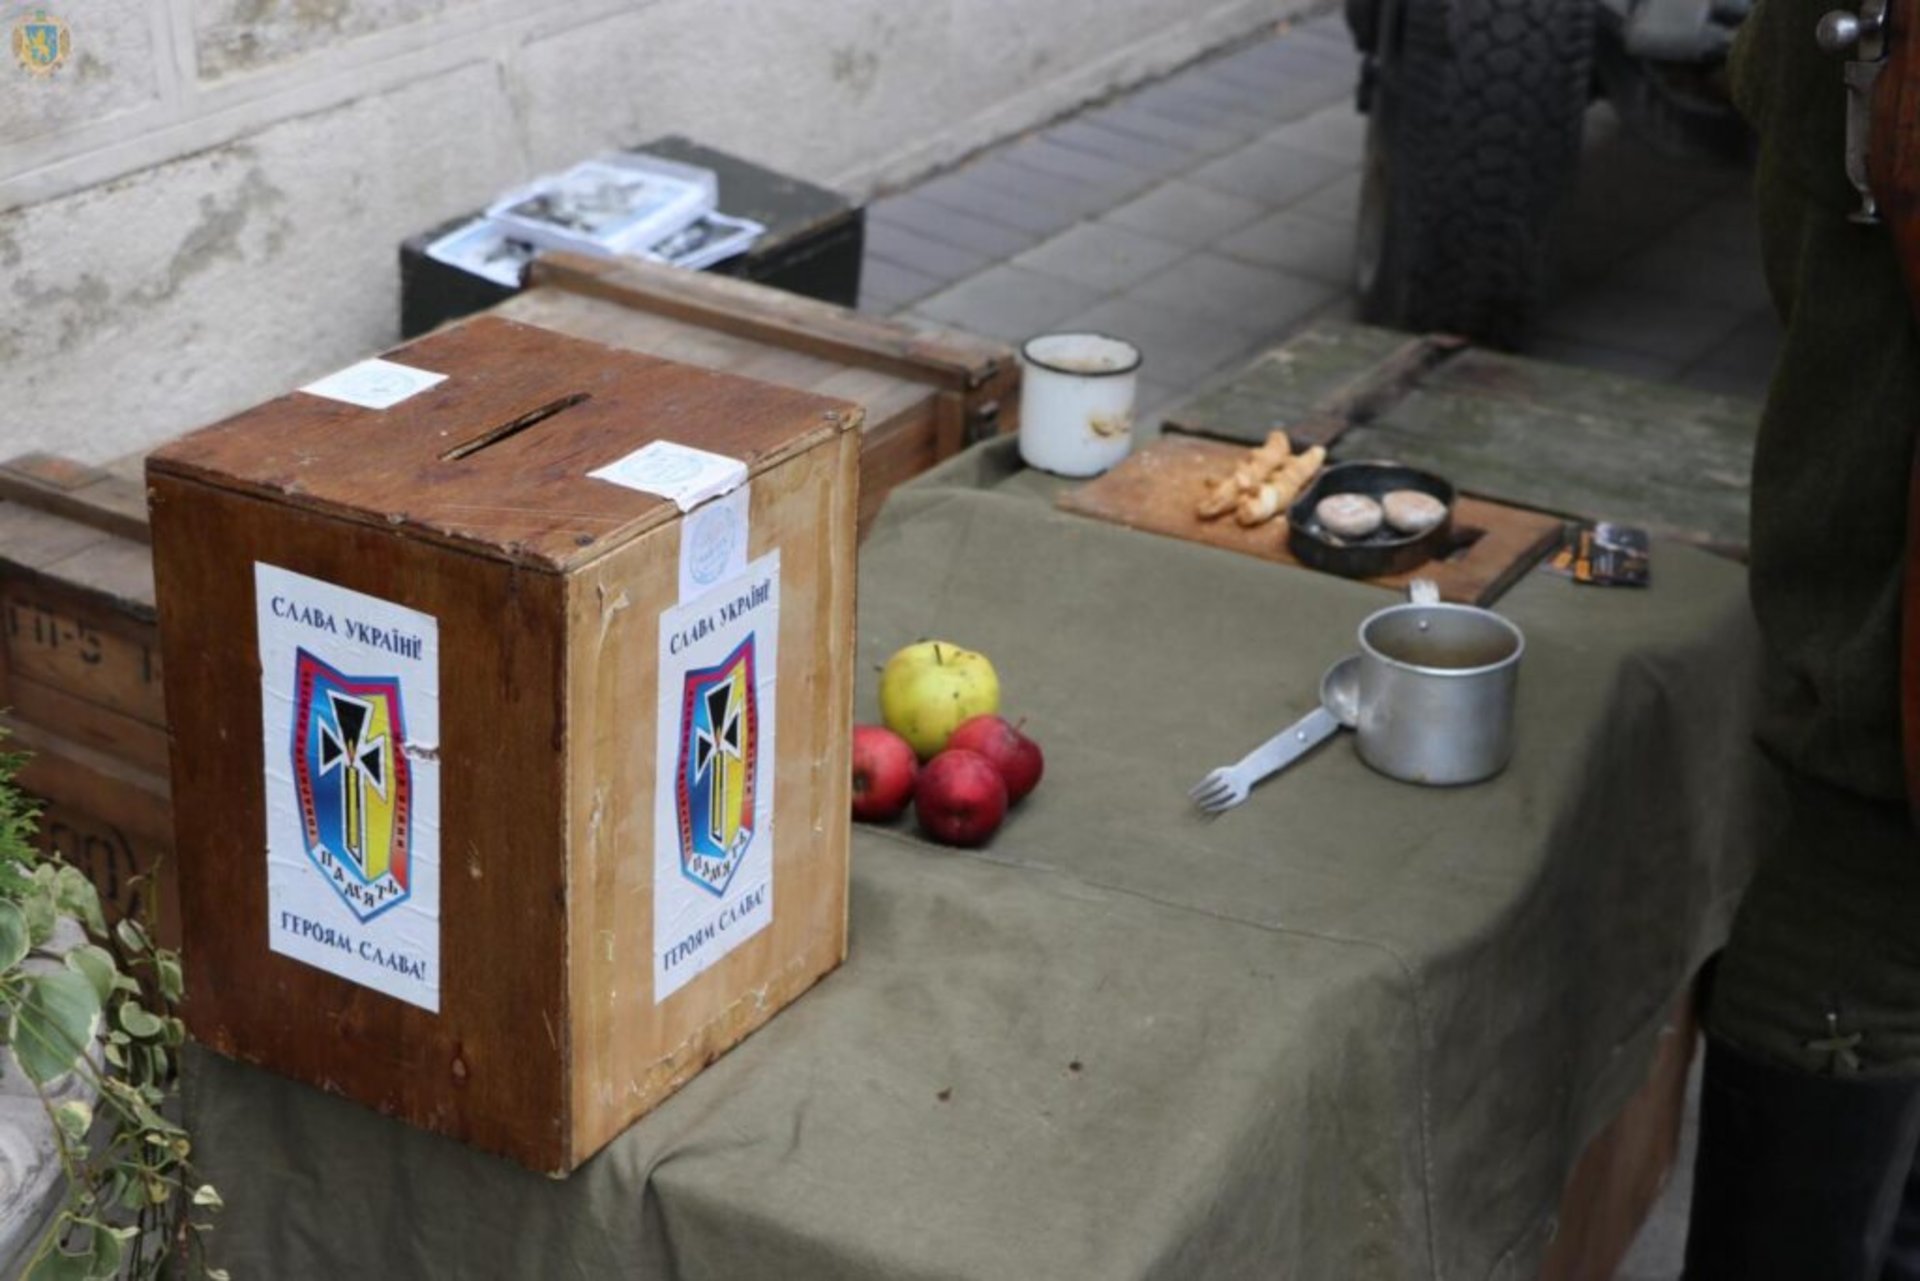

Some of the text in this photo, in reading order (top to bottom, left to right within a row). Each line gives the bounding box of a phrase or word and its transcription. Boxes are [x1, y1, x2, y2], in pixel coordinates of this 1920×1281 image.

[271, 596, 422, 660] СЛАВА УКРАЇНІ!
[670, 615, 715, 655] СЛАВА
[281, 911, 427, 981] ГЕРОЯМ СЛАВА!
[663, 883, 767, 971] ГЕРОЯМ СЛАВА!
